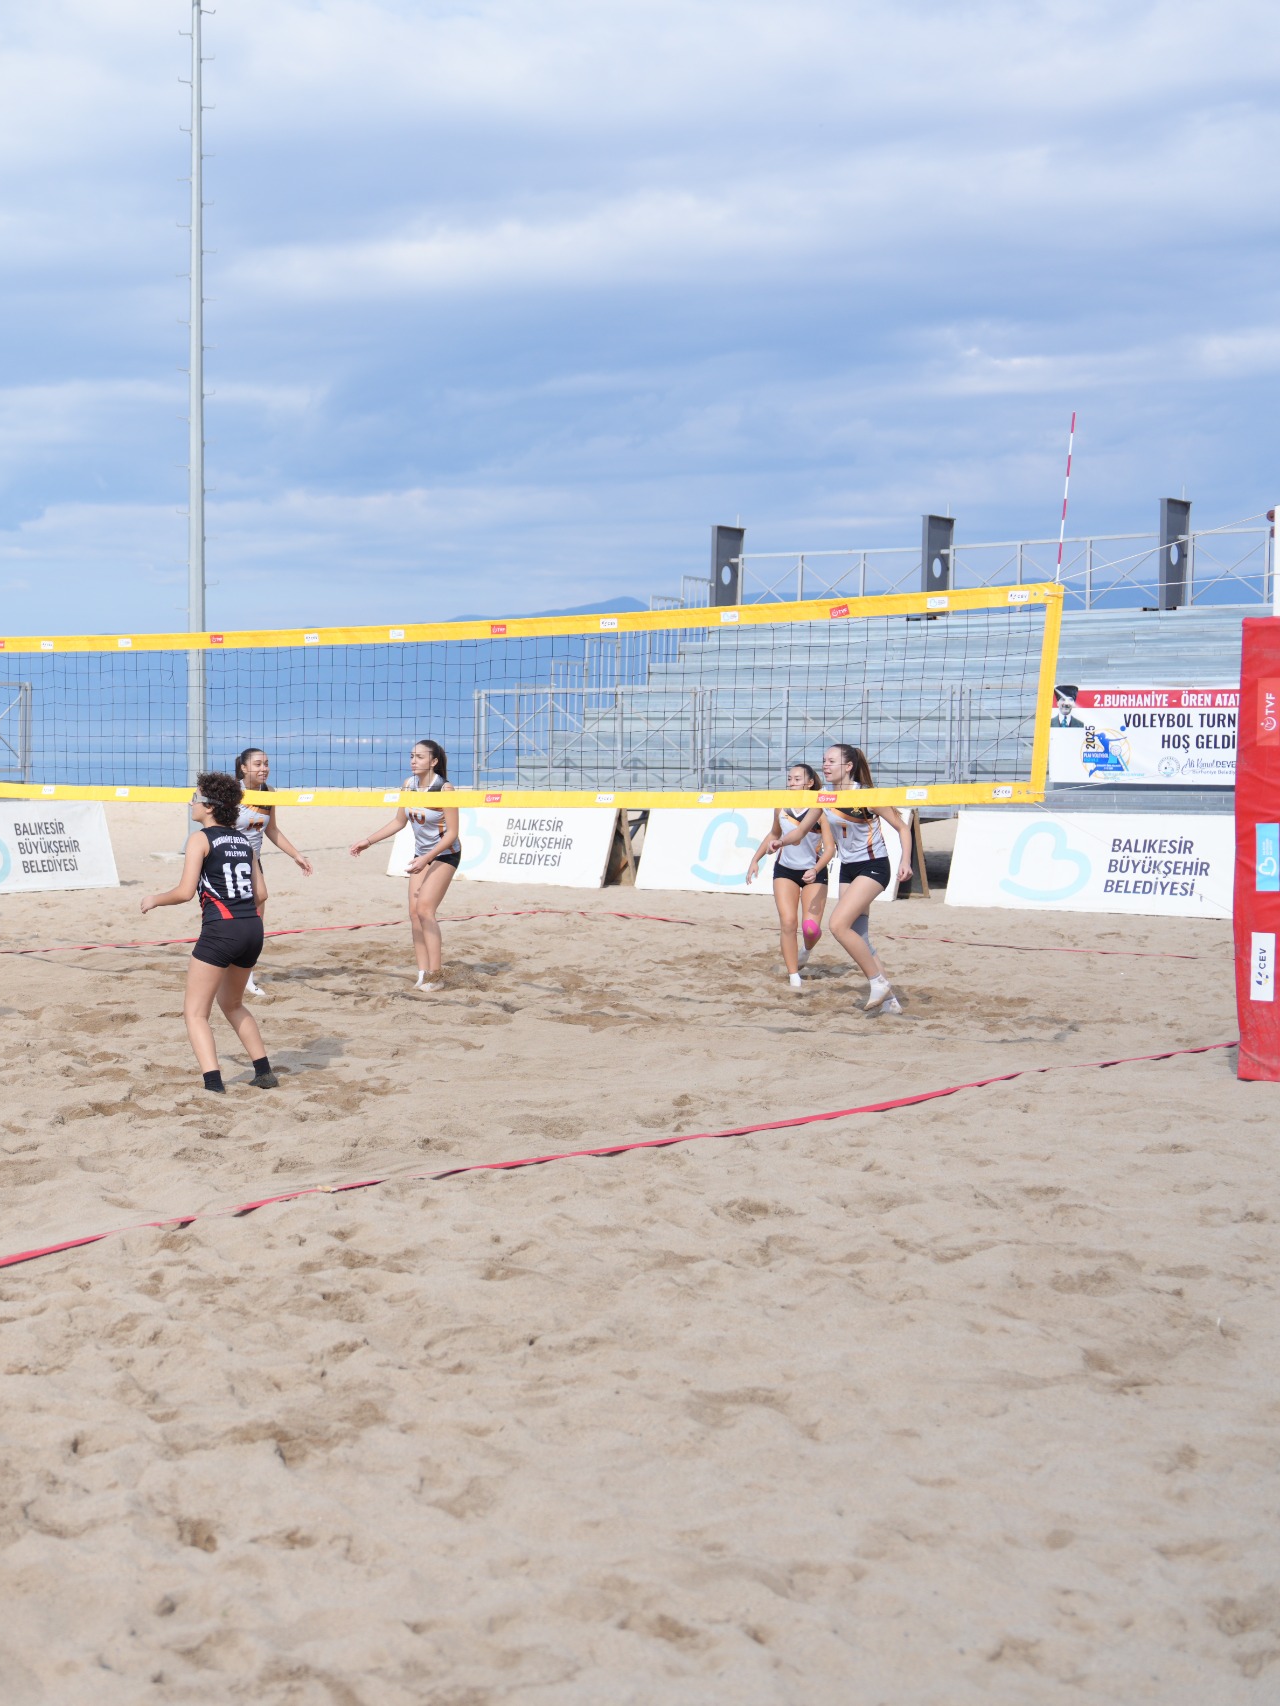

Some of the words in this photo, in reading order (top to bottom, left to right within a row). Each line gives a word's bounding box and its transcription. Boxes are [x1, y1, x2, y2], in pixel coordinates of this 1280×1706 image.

[1093, 691, 1169, 707] 2.BURHANİYE
[1181, 691, 1212, 707] ÖREN
[1215, 693, 1240, 707] ATAT
[1265, 692, 1276, 715] TVF
[1123, 713, 1194, 728] VOLEYBOL
[1199, 713, 1237, 728] TURN
[1085, 725, 1096, 750] 2025
[1161, 734, 1190, 753] HOŞ
[1195, 731, 1236, 749] GELDİ
[14, 818, 66, 837] BALIKESİR
[506, 816, 564, 833] BALIKESİR
[17, 836, 81, 857] BÜYÜKŞEHİR
[502, 832, 573, 852] BÜYÜKŞEHİR
[1111, 836, 1195, 855] BALIKESİR
[22, 855, 79, 874] BELEDİYESİ
[498, 850, 562, 868] BELEDİYESİ
[1107, 856, 1211, 879] BÜYÜKŞEHİR
[222, 862, 254, 899] 16
[1103, 876, 1197, 897] BELEDİYESİ
[1258, 948, 1267, 970] CEV
